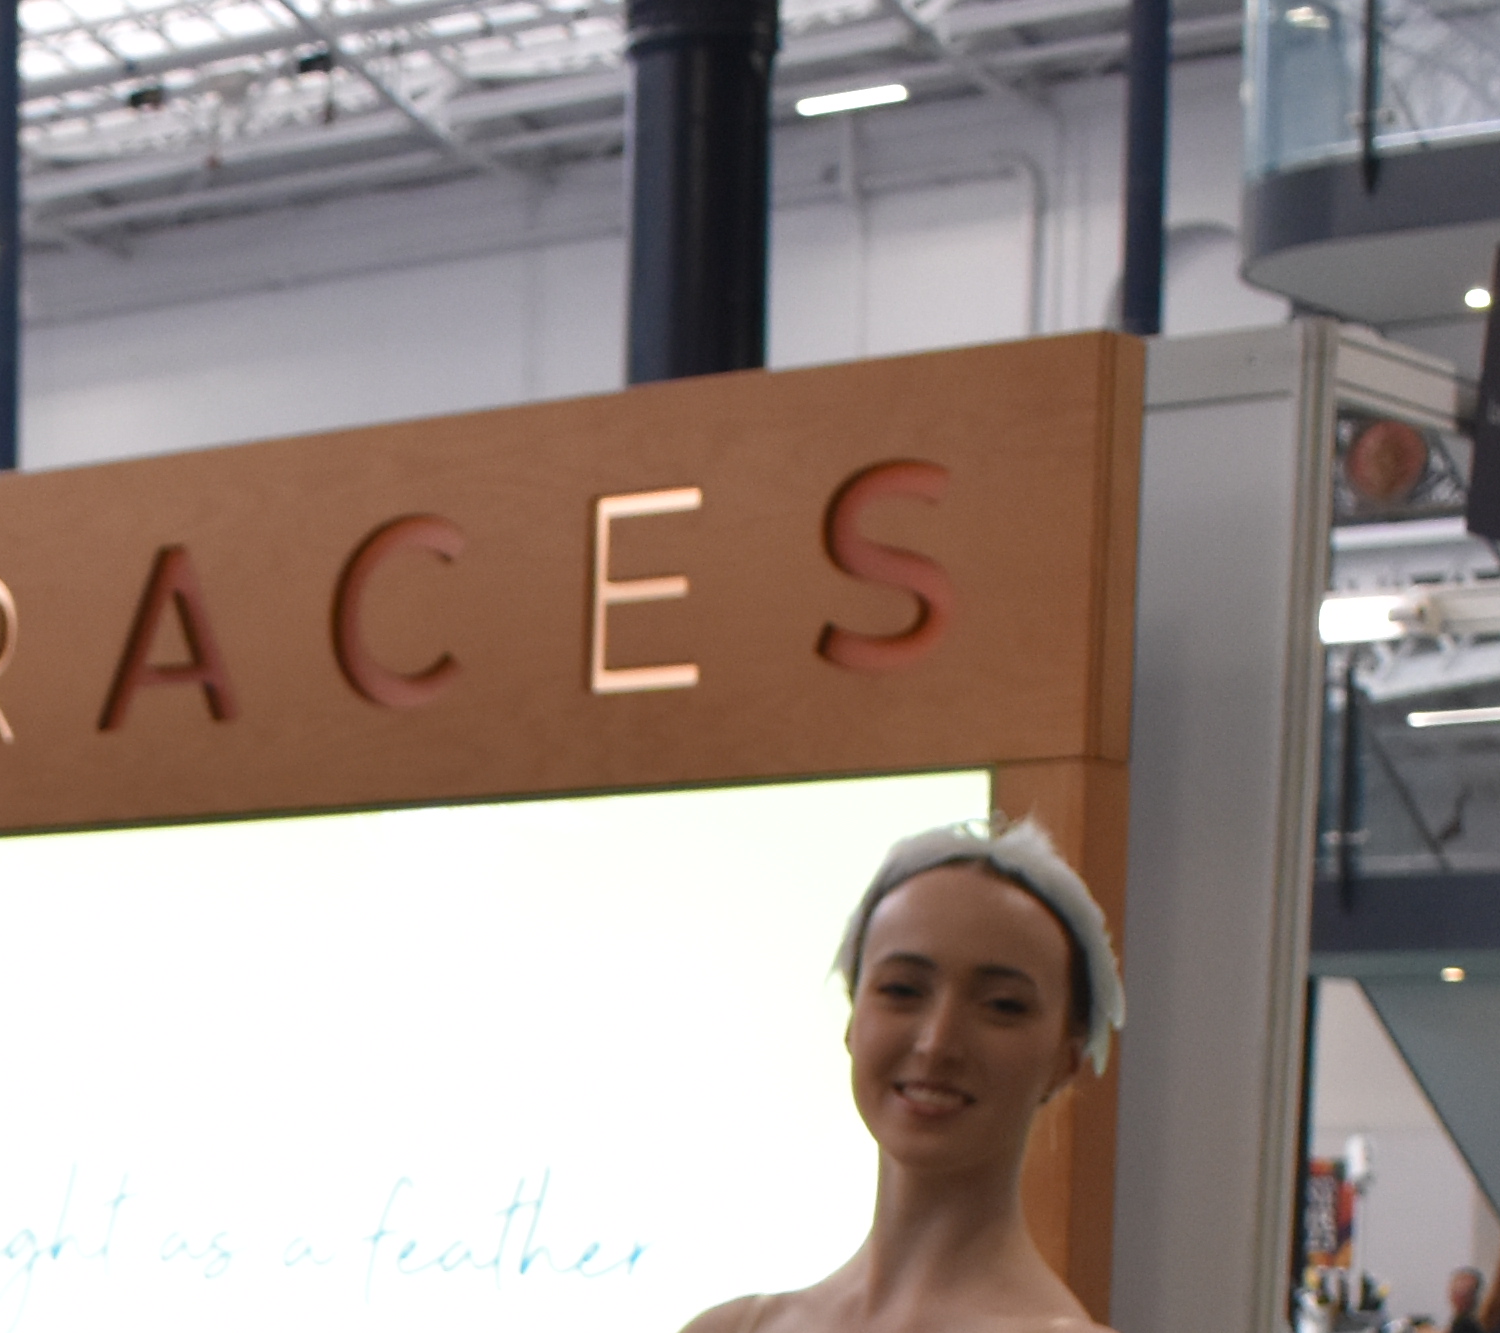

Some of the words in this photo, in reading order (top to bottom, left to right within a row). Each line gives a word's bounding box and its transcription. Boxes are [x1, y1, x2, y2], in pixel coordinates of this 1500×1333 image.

[160, 1228, 235, 1280] as
[284, 1234, 336, 1268] a
[360, 1164, 650, 1305] feather
